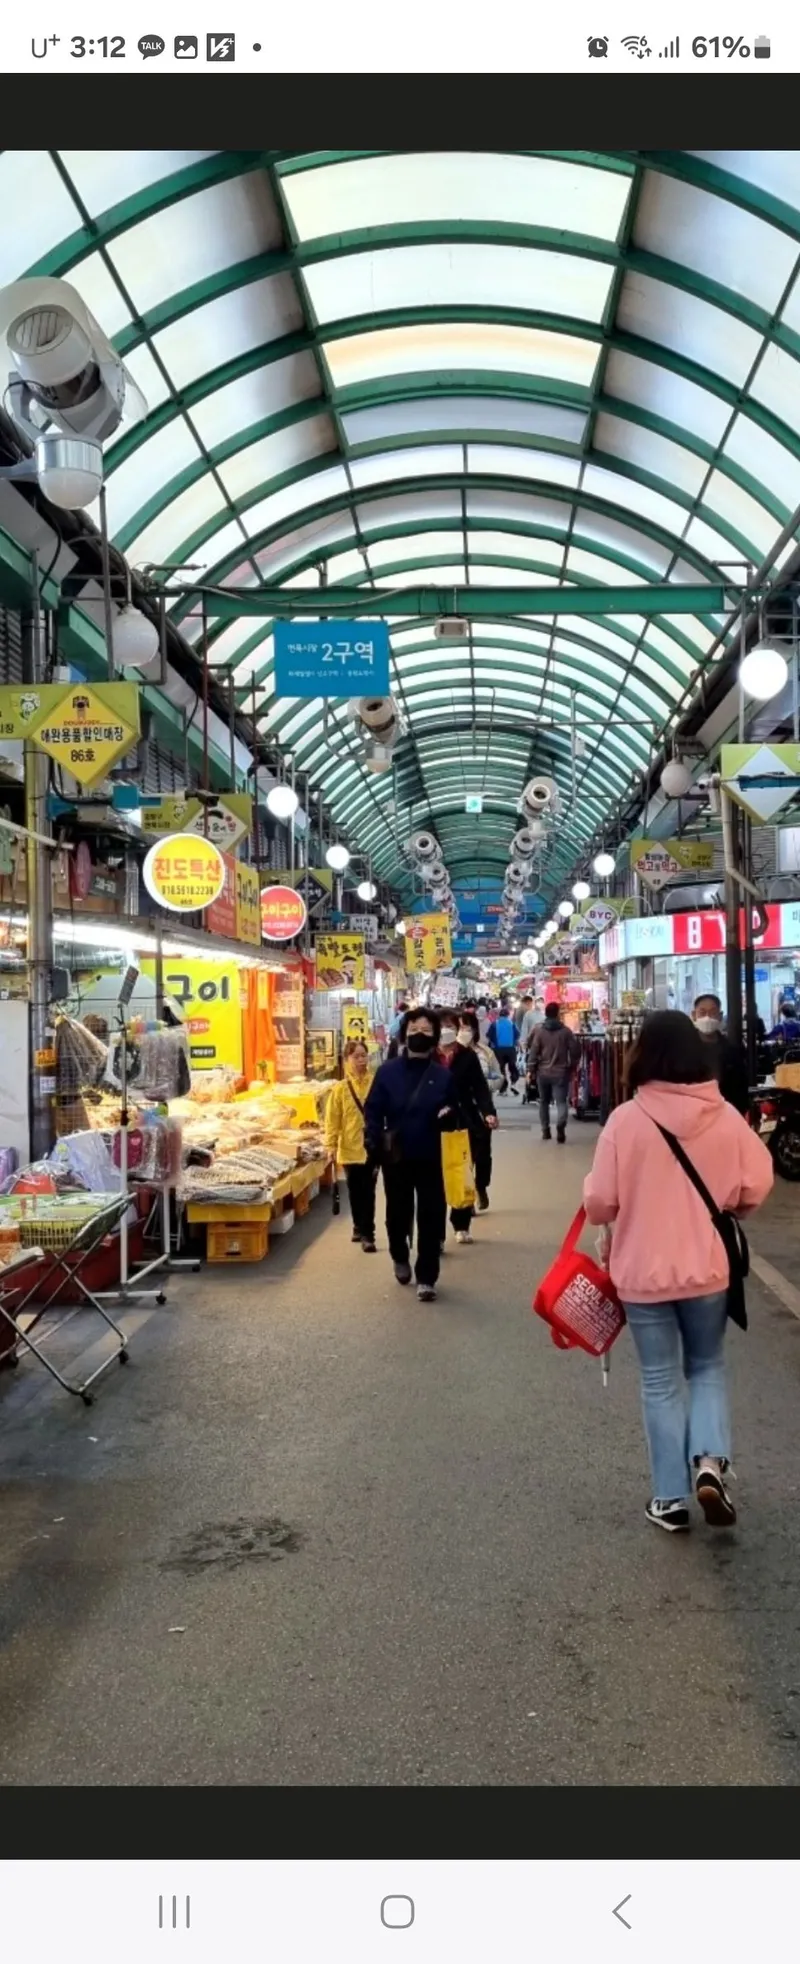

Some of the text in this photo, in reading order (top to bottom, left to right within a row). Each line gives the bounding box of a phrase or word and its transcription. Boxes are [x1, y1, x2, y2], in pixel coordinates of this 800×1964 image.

[321, 641, 374, 665] 2구역
[155, 857, 221, 881] 진도특산
[590, 910, 612, 921] BYC
